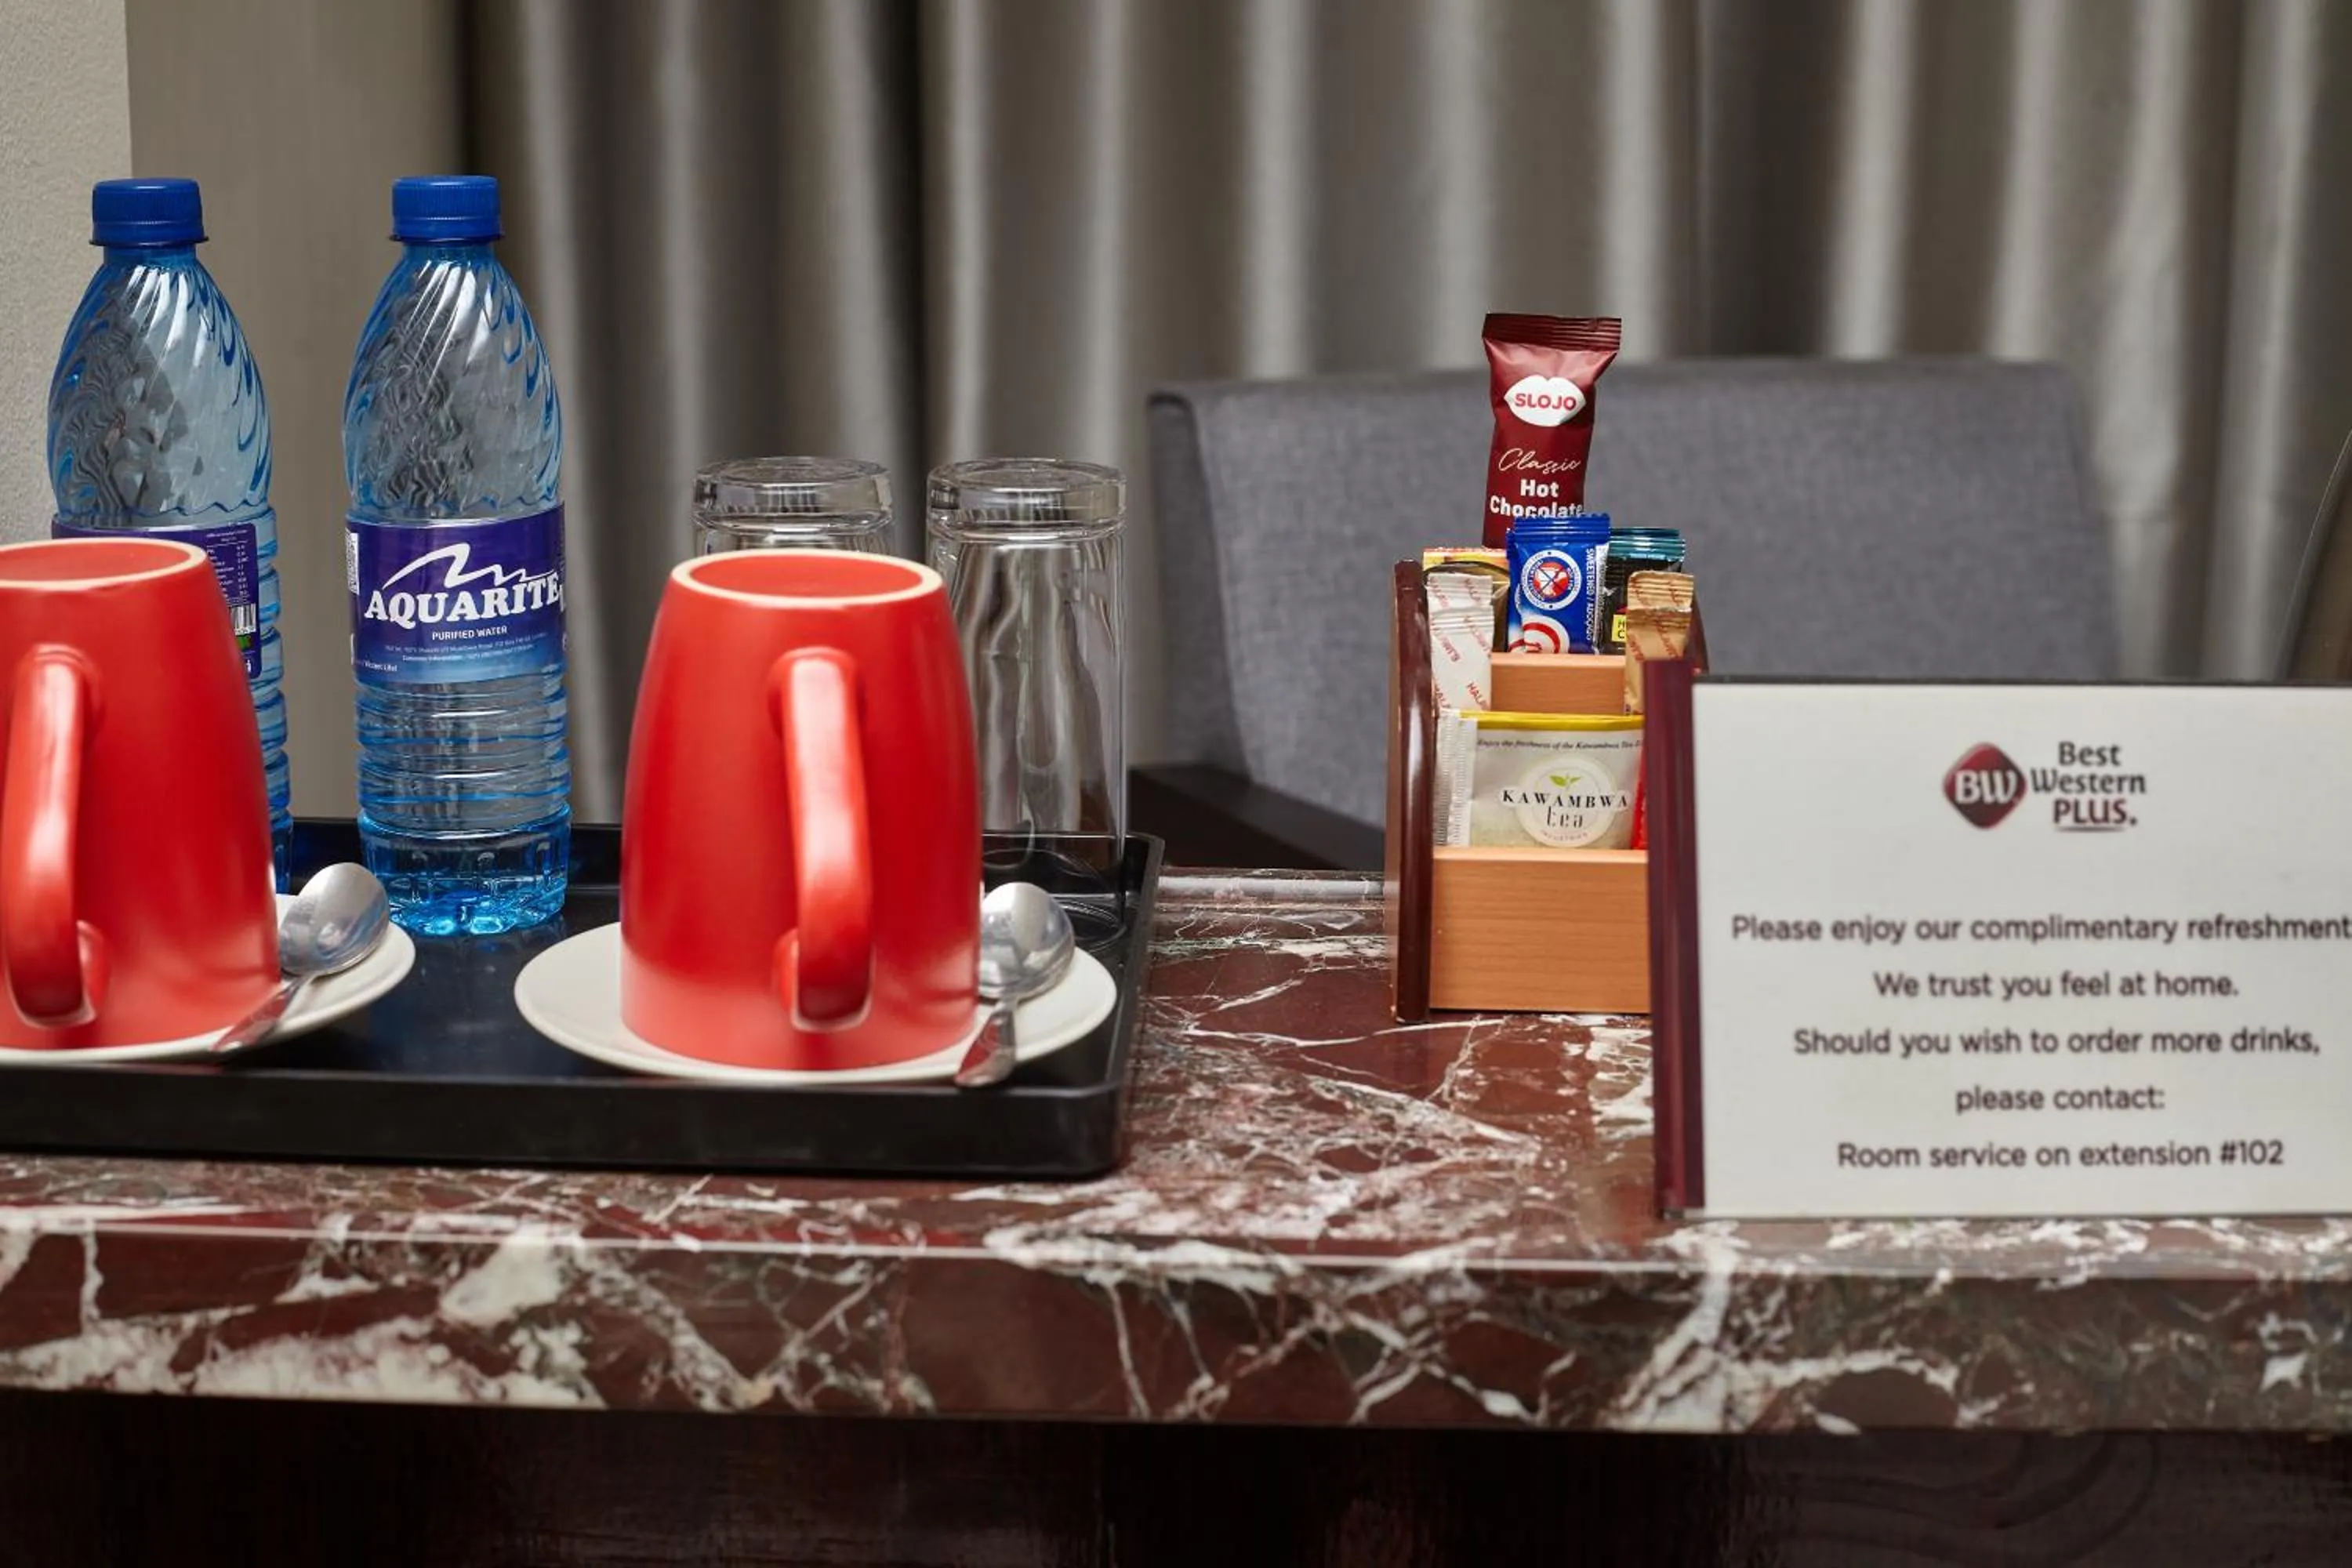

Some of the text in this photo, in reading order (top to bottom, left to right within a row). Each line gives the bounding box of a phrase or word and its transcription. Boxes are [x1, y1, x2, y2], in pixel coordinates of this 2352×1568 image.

[1515, 393, 1577, 411] SLOJO
[1498, 448, 1581, 474] Classic
[1520, 478, 1559, 498] Hot
[1585, 547, 1595, 596] SWEETENED
[364, 571, 561, 629] AQUARITE
[432, 624, 508, 641] PURIFIED WATER
[2058, 741, 2122, 766] Best
[1955, 768, 2019, 804] BW
[2031, 768, 2147, 795] Western
[1502, 789, 1628, 808] KAWAMBWA
[1546, 805, 1584, 829] tea
[1733, 915, 1823, 941] Please
[1831, 916, 1907, 946] enjoy
[1915, 920, 1962, 941] our
[1969, 915, 2179, 945] complimentary
[1873, 970, 2239, 1002] We trust you feel at home.
[1794, 1026, 2321, 1059] Should you wish to order more drinks,
[1955, 1085, 2165, 1115] please contact:
[1838, 1139, 2284, 1168] Room service on extension #102
